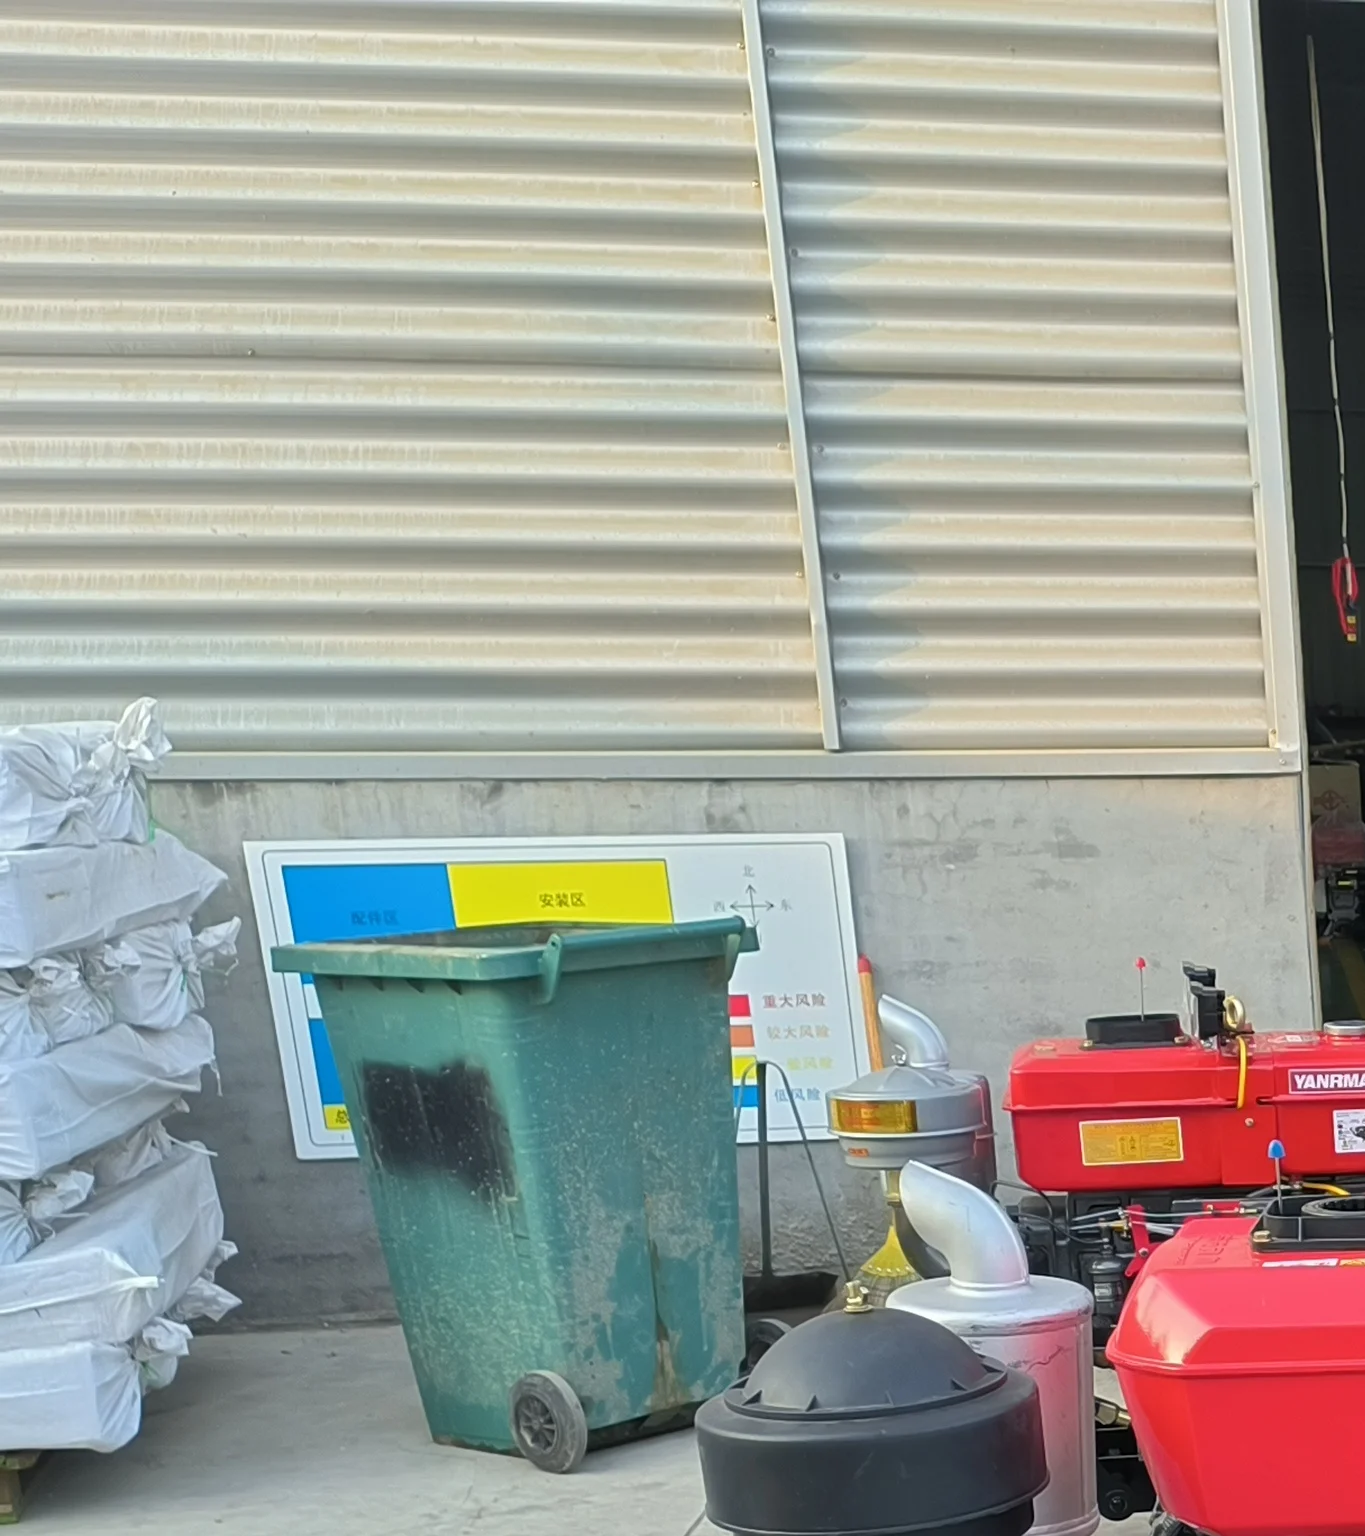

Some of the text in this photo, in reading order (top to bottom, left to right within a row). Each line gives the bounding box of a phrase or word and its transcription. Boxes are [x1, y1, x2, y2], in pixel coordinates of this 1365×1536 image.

[538, 891, 587, 909] 安装区
[351, 910, 400, 927] 配件区
[762, 993, 827, 1009] 重大风险
[767, 1024, 832, 1040] 较大风险
